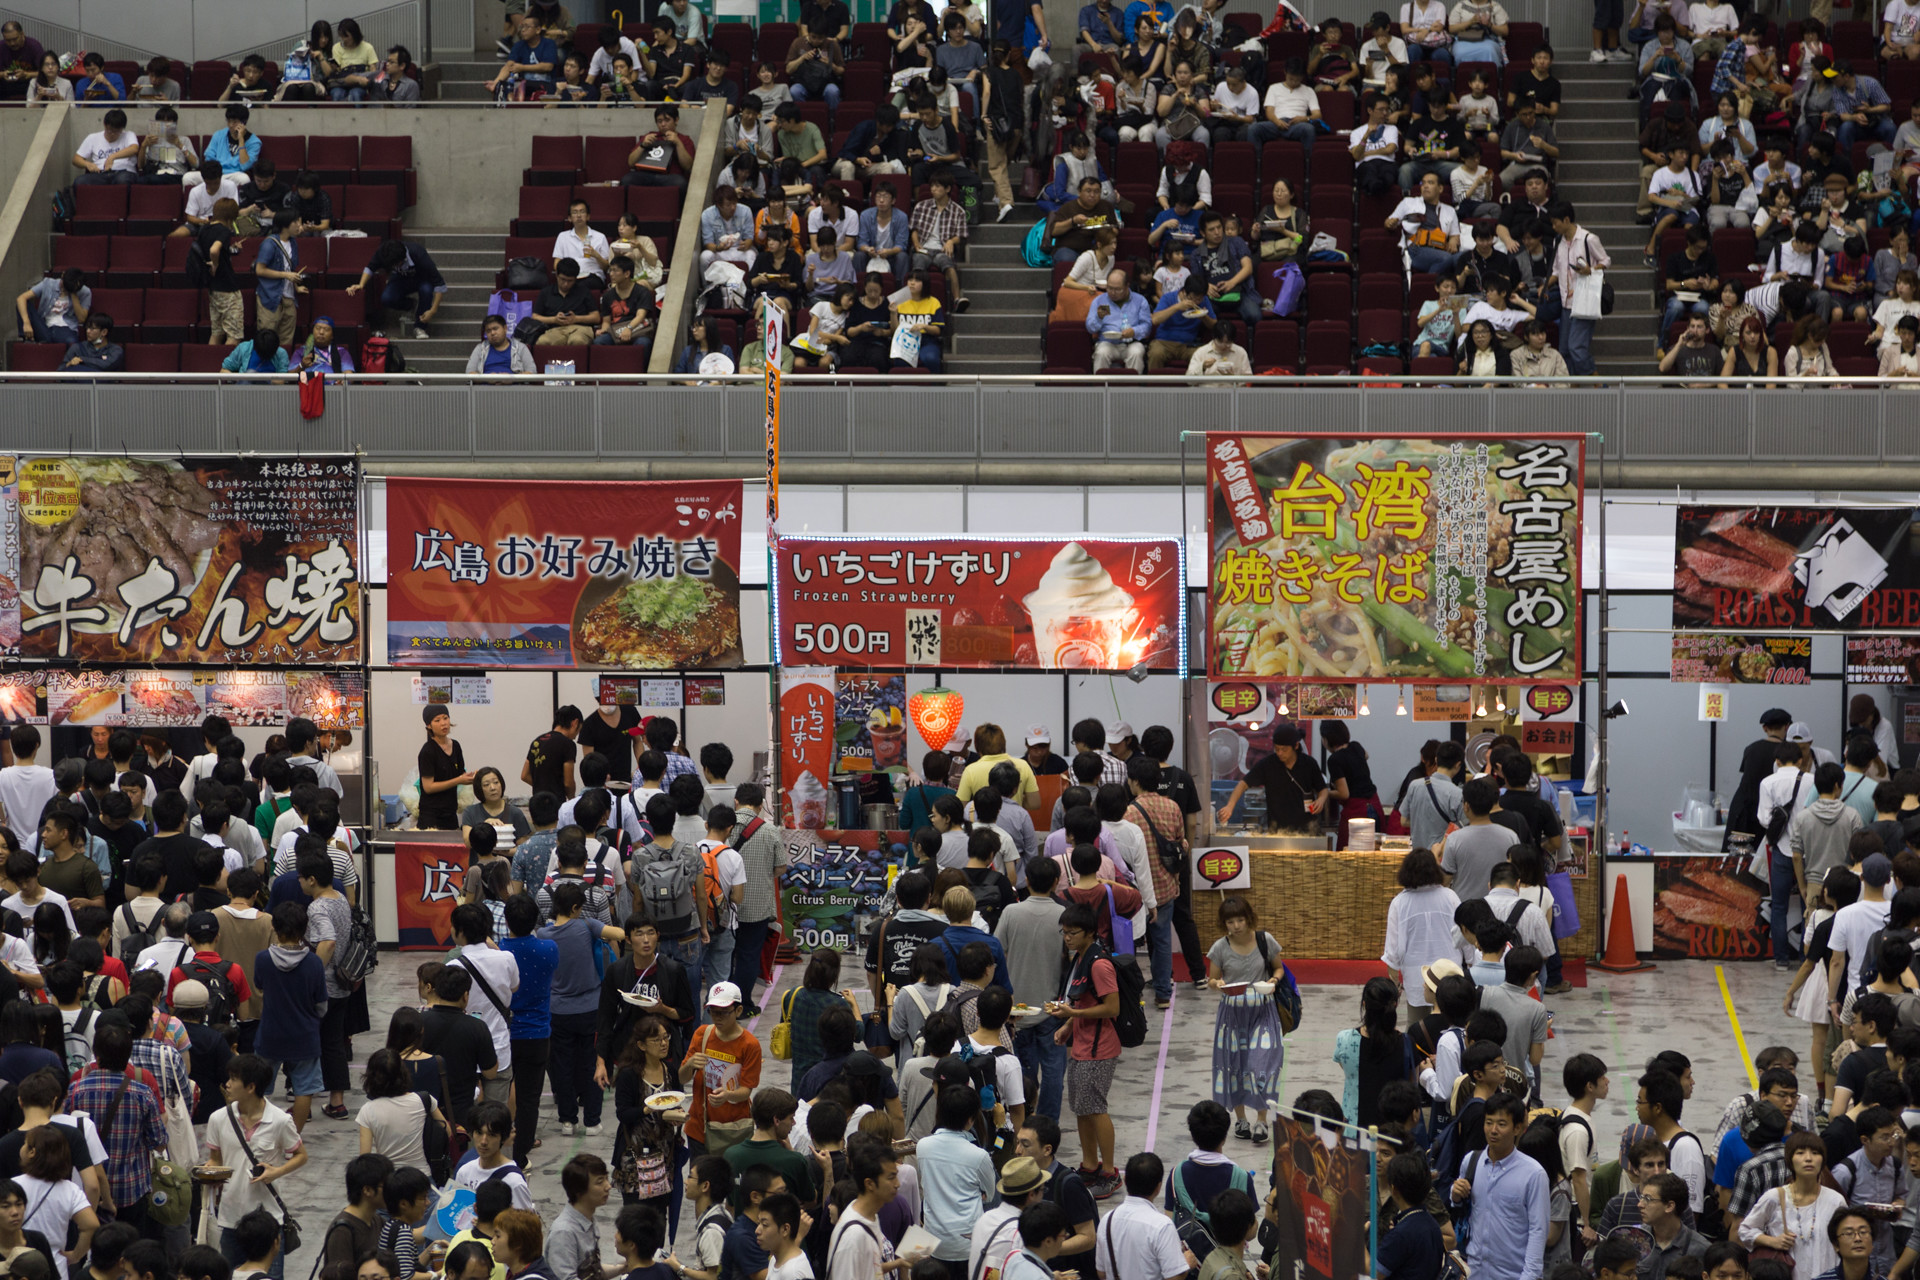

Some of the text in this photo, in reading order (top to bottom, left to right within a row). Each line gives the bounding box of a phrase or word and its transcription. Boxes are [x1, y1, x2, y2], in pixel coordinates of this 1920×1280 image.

[259, 462, 356, 477] 本格絶品の味
[1214, 438, 1270, 542] 名古屋名物
[1272, 460, 1432, 542] 台湾
[676, 502, 736, 526] このや
[1462, 454, 1475, 578] こだわりのこの焼きそば
[5, 500, 18, 581] ビーフステーキ
[412, 529, 718, 584] 広島 お好み焼き
[1474, 443, 1488, 675] 台湾ラーメン専門店が自信をもって作り上げる
[1495, 443, 1575, 674] 名古屋めし
[792, 550, 1010, 586] いちごけずり
[1218, 548, 1429, 606] 焼きそば
[22, 539, 355, 657] 牛たん焼
[793, 590, 956, 605] Frozen Strawberry
[794, 623, 890, 654] 500円
[47, 670, 124, 692] 牛たんドッグ
[125, 672, 162, 682] USA BEEF
[148, 682, 192, 690] STEAK DOG
[217, 672, 285, 684] USA BEEF STEAK
[839, 680, 880, 691] シトラス
[840, 692, 874, 704] ベリー
[1221, 690, 1256, 708] 旨辛
[1534, 691, 1568, 708] 旨辛
[1706, 694, 1722, 718] 完売
[808, 693, 824, 742] いちご
[840, 703, 874, 715] ソーダ
[128, 714, 195, 726] ステーキドッグ
[790, 715, 807, 764] けずり
[1526, 728, 1572, 745] お会計
[842, 746, 872, 756] 500円
[790, 844, 862, 863] シトラス
[1204, 858, 1237, 876] 旨辛
[792, 894, 883, 907] Citrus Berry Sod
[793, 929, 849, 947] 500円
